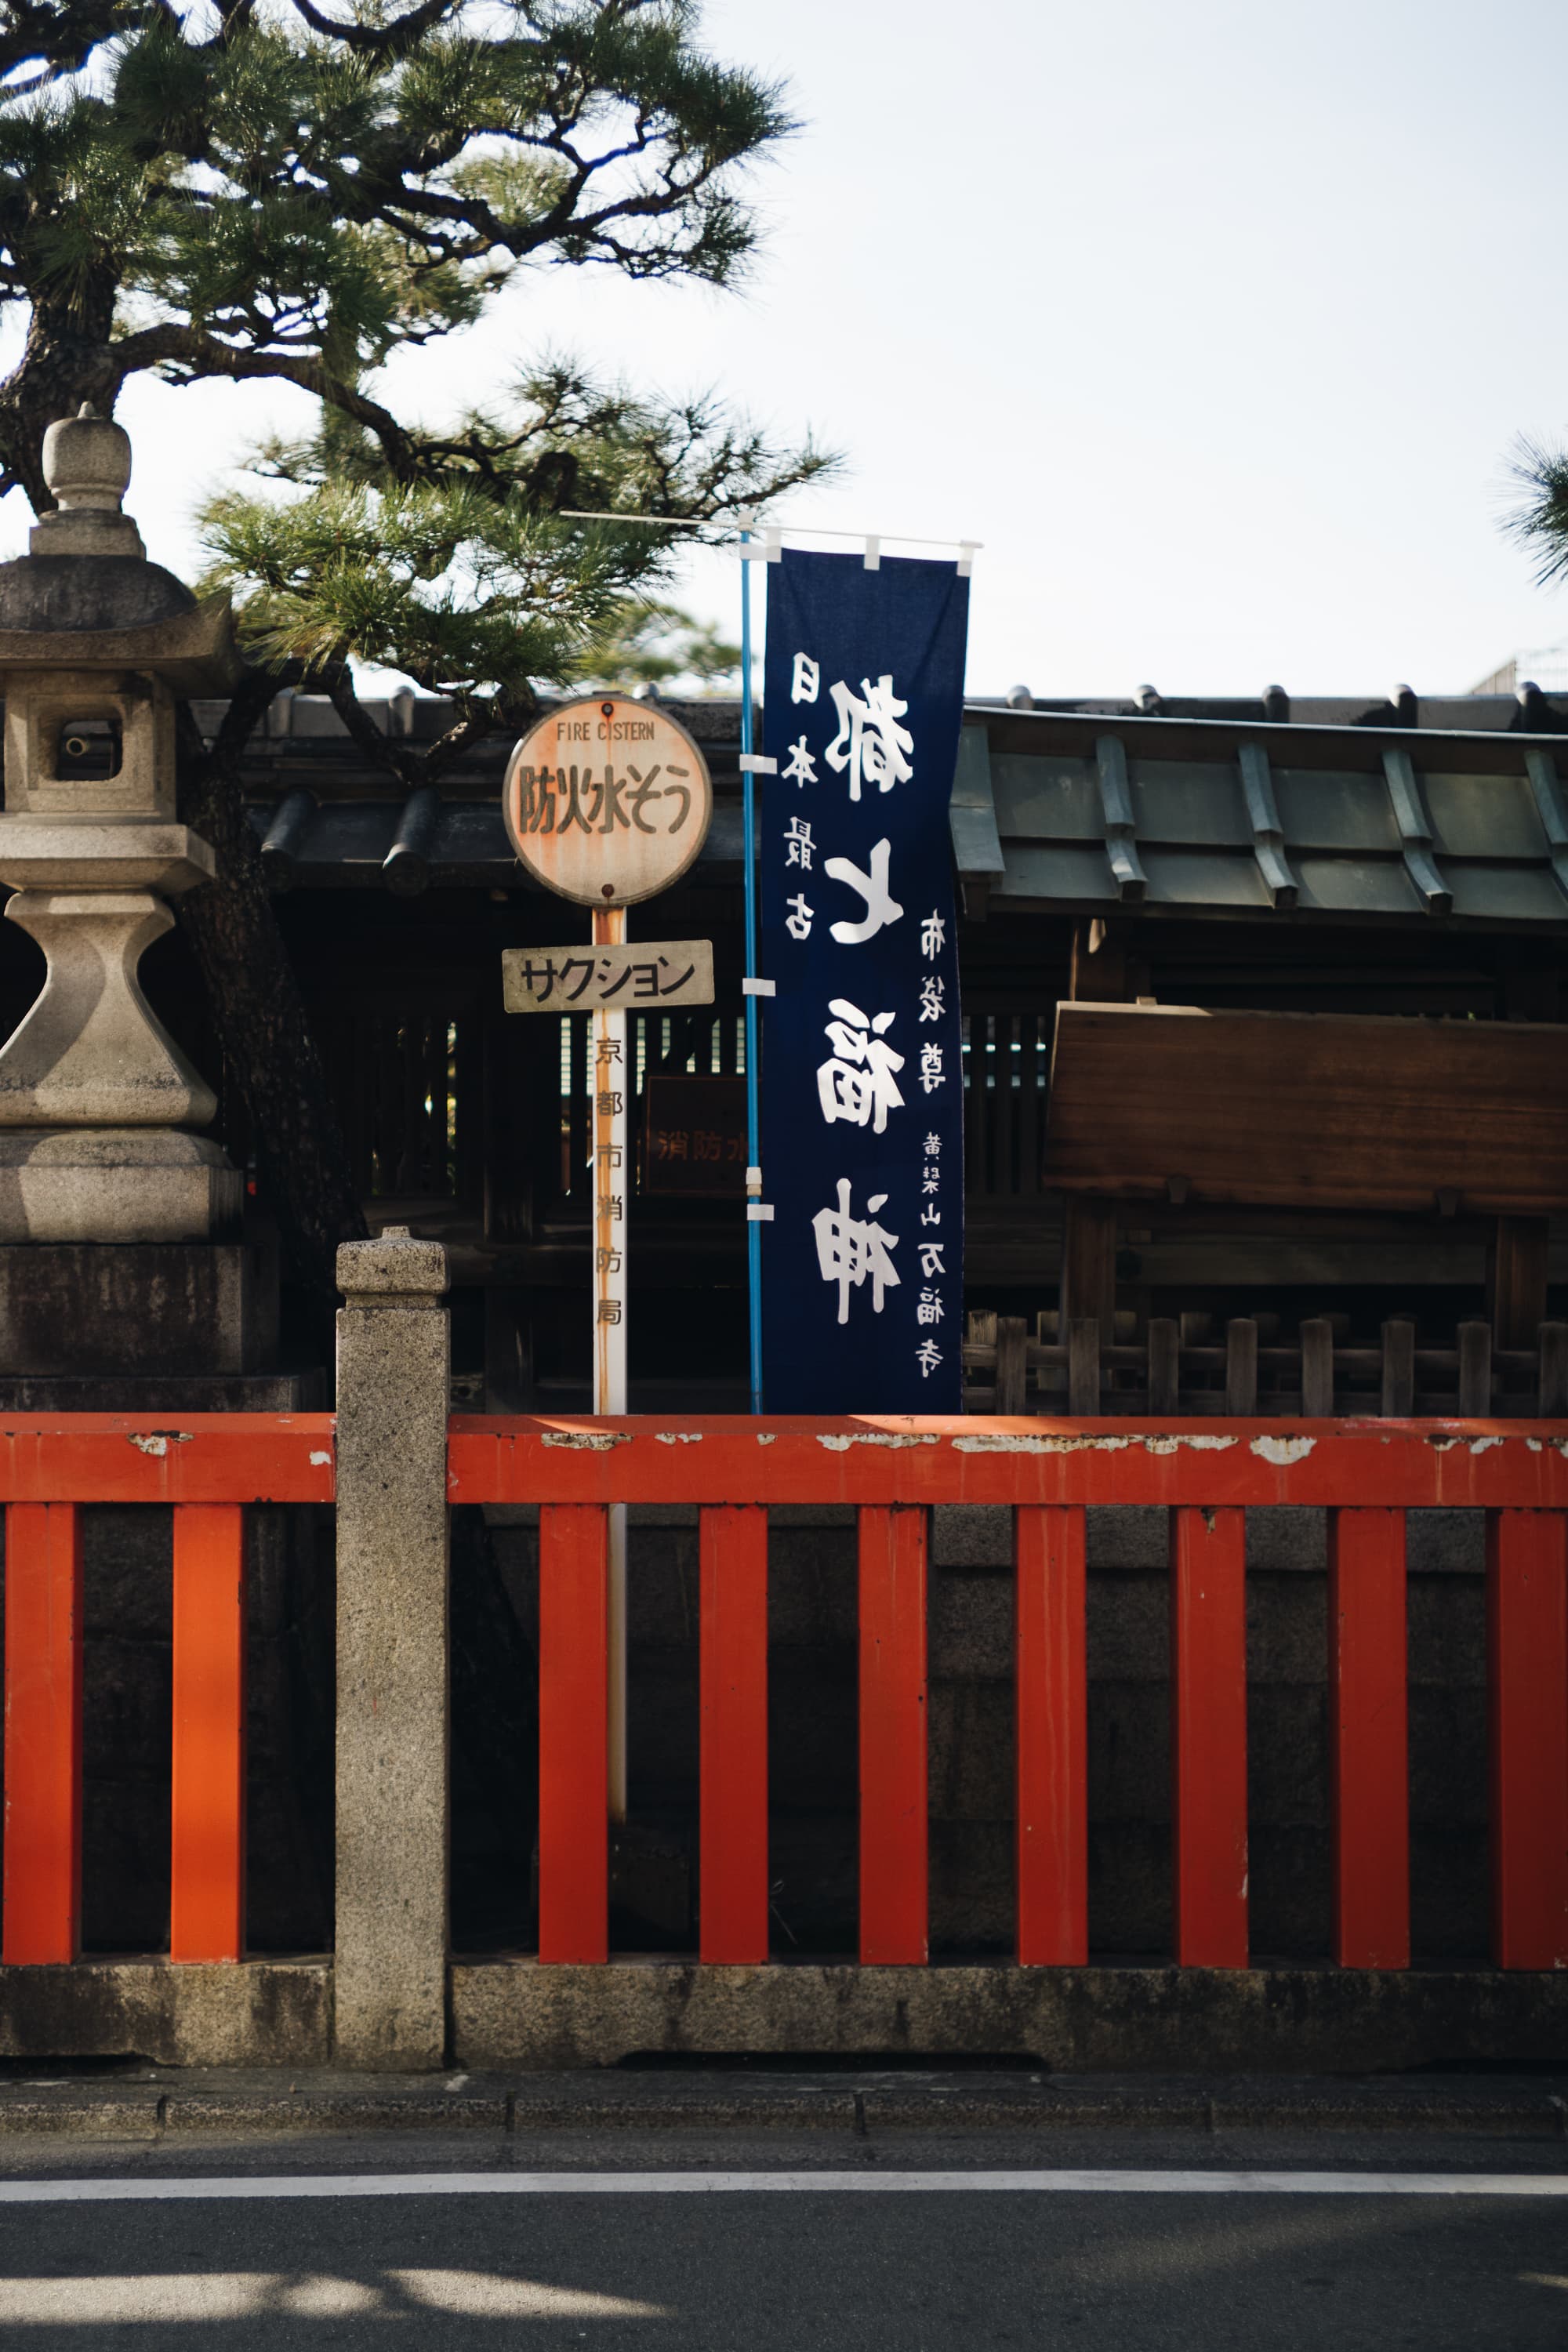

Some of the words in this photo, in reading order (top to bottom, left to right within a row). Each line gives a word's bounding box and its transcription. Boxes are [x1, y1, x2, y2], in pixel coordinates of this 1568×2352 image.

[557, 721, 590, 741] FIRE
[597, 720, 655, 741] CISTERN
[520, 764, 691, 834] 防火水そう
[521, 956, 695, 1003] サクション
[658, 1130, 762, 1161] 消防水
[595, 1037, 623, 1325] 京都市消防局
